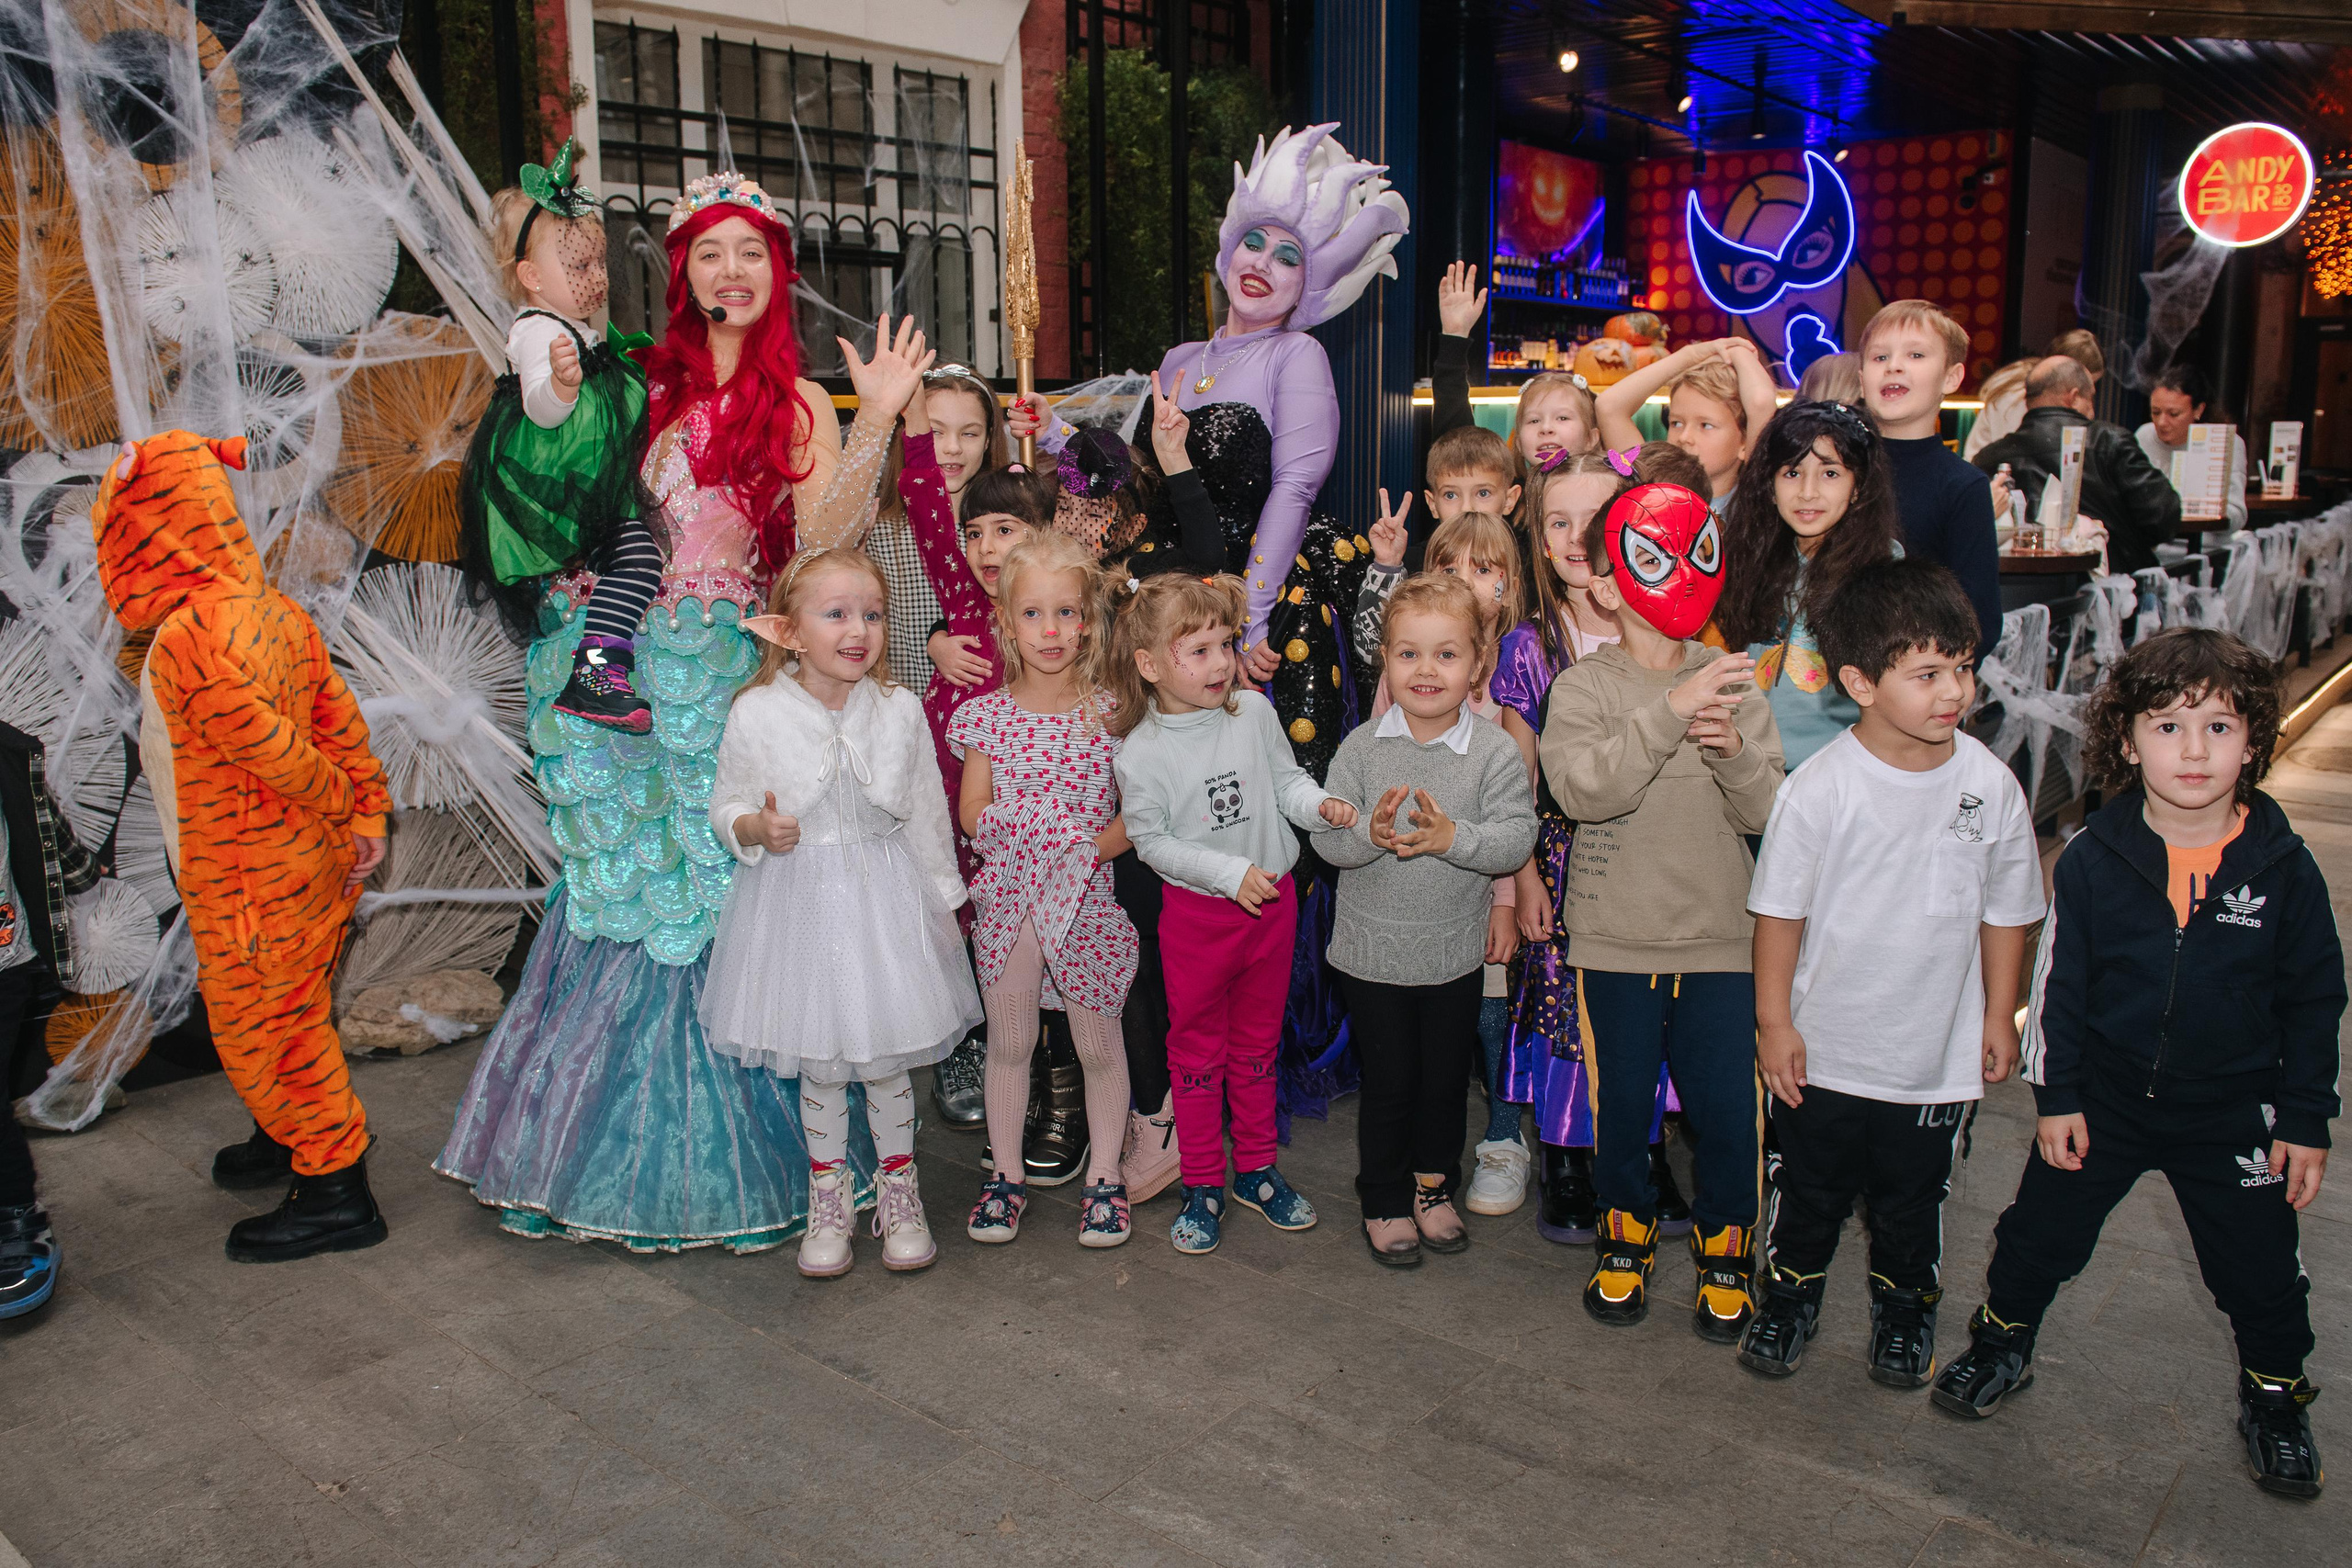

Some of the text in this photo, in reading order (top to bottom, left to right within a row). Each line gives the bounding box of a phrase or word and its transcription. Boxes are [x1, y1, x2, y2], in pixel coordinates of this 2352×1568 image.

[2198, 154, 2296, 187] ANDY
[2197, 185, 2270, 215] BAR
[1204, 771, 1237, 785] 50% PANDA
[1211, 816, 1250, 832] 50% UNICORN
[1580, 840, 1621, 852] YOUR STORY
[1590, 868, 1607, 878] LONG
[2216, 913, 2261, 929] adidas
[1613, 1258, 1633, 1268] KKD
[1715, 1272, 1736, 1285] KKD
